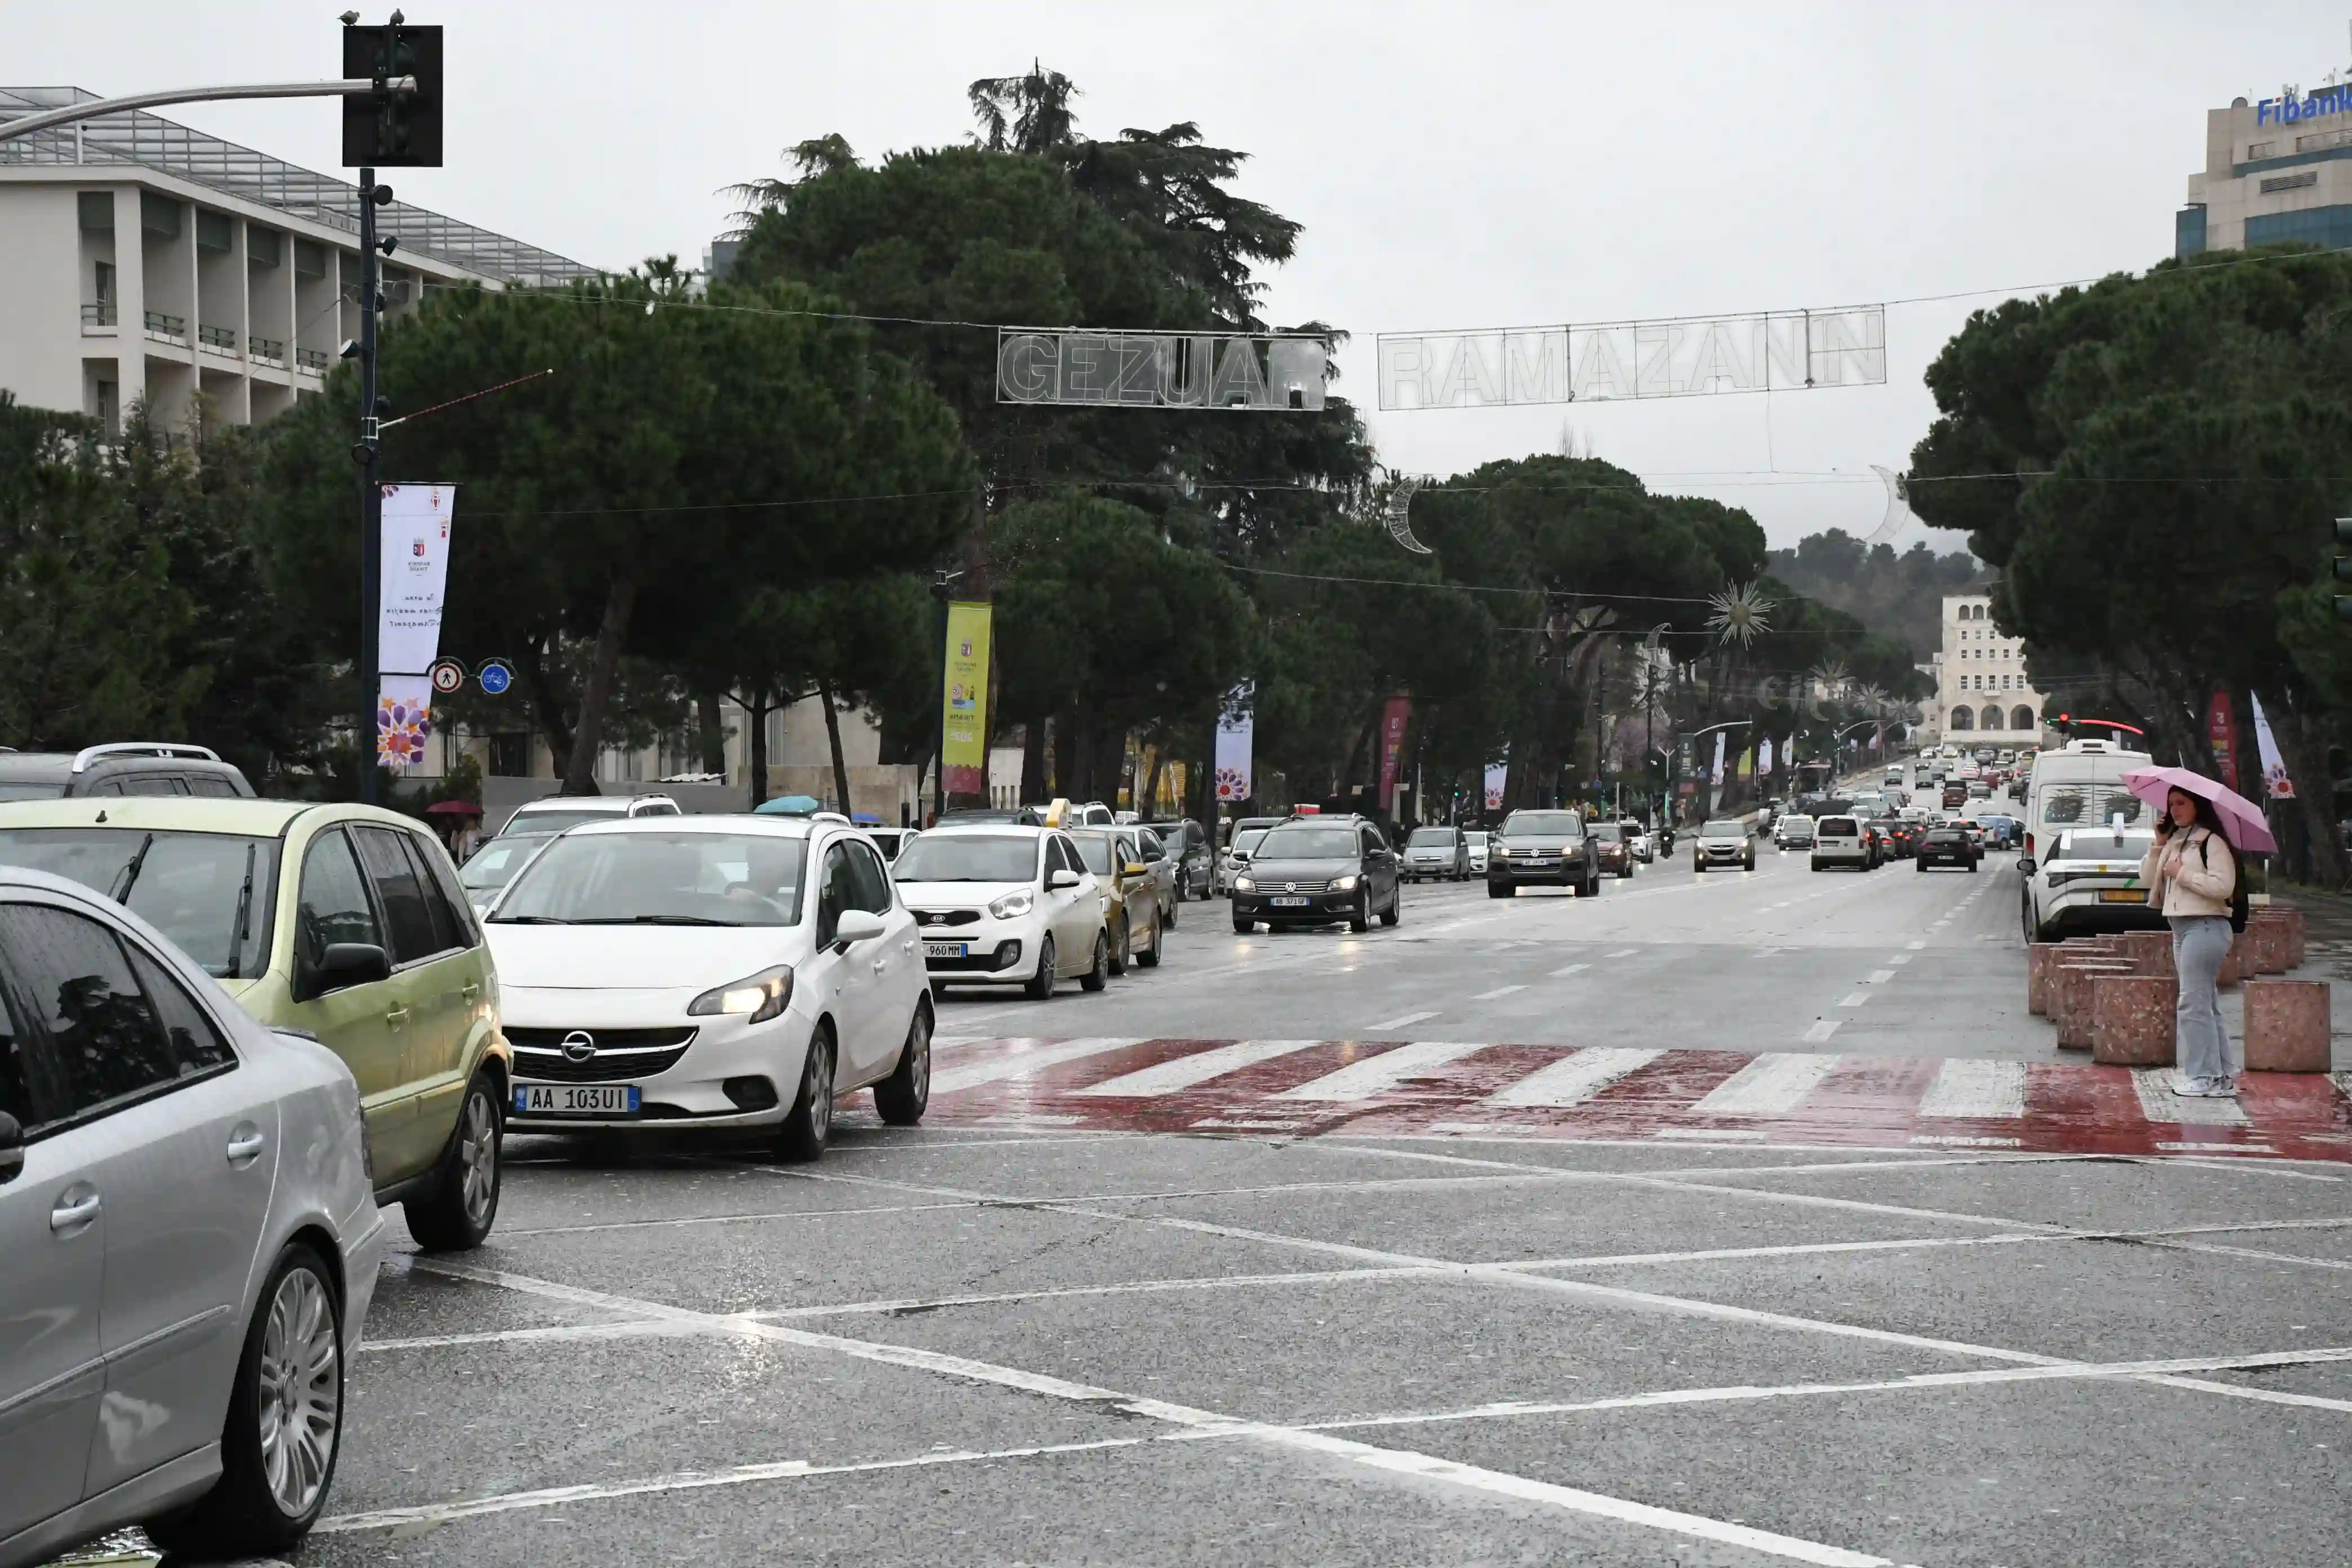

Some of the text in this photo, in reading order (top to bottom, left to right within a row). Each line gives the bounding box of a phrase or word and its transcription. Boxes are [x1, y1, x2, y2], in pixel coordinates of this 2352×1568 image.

[999, 313, 1883, 410] GEZUAR RAMAZANIN
[531, 1088, 554, 1108] AA
